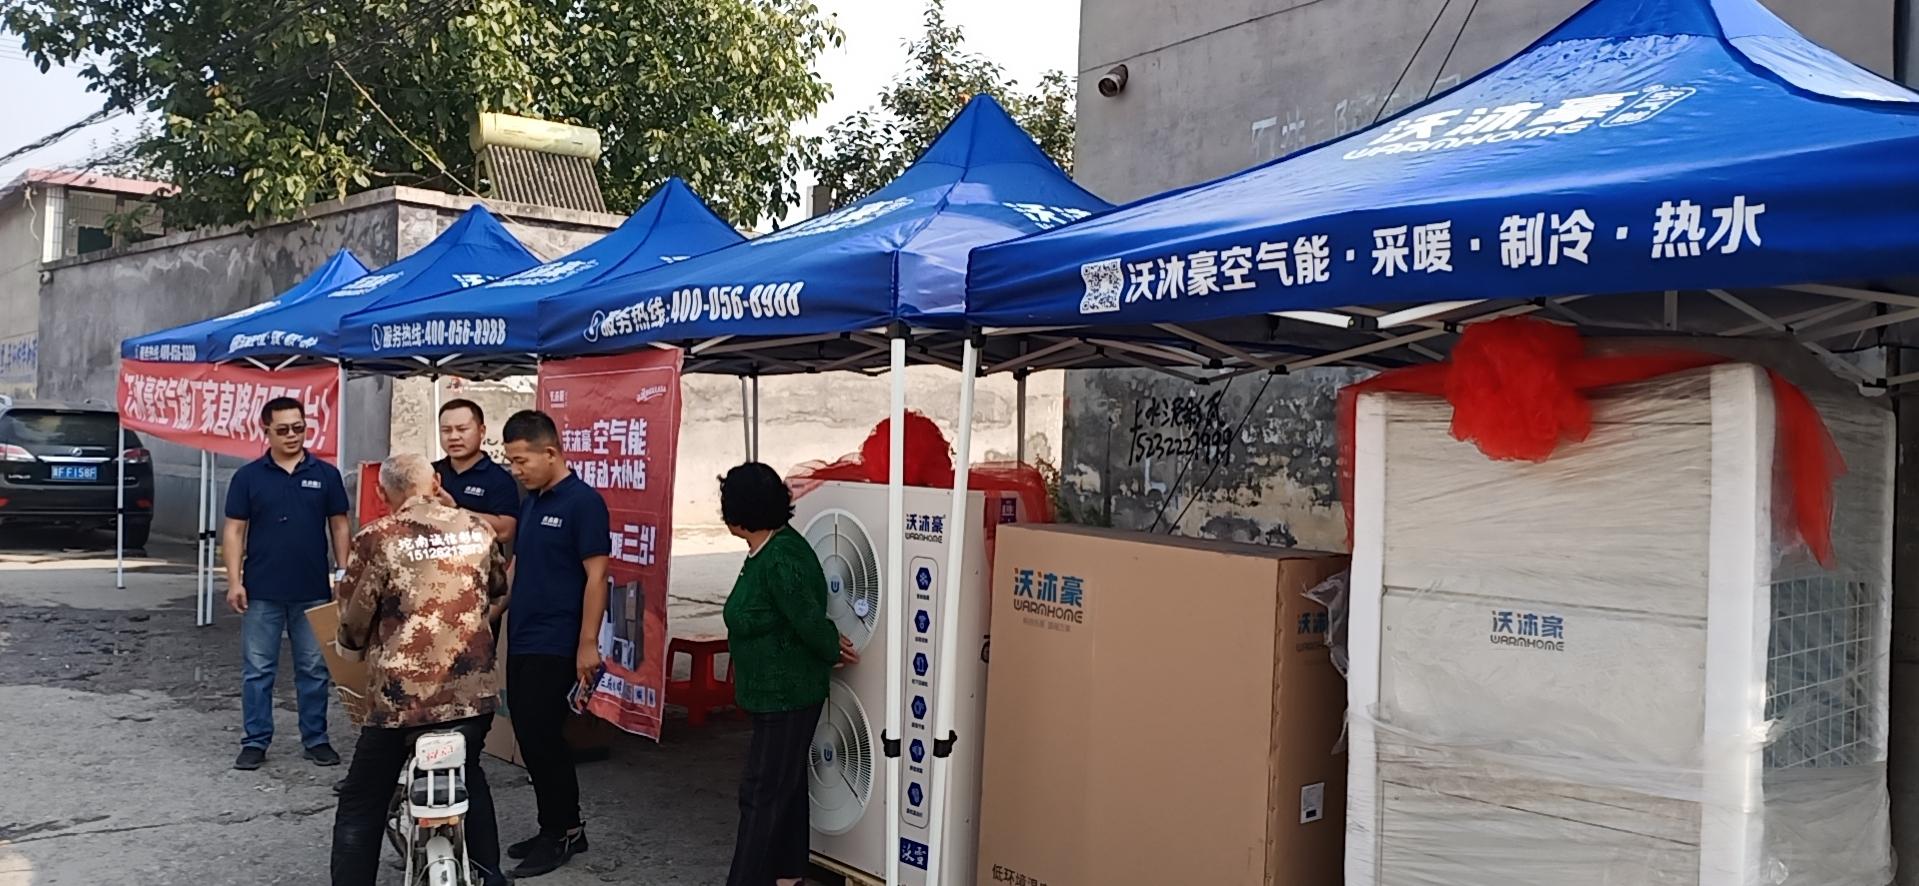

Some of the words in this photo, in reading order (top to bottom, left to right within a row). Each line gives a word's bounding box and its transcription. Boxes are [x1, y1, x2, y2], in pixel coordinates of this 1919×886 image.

[1013, 567, 1084, 608] 沃沐豪
[1013, 598, 1084, 624] WARMHOME
[1489, 634, 1565, 652] WARMHOME
